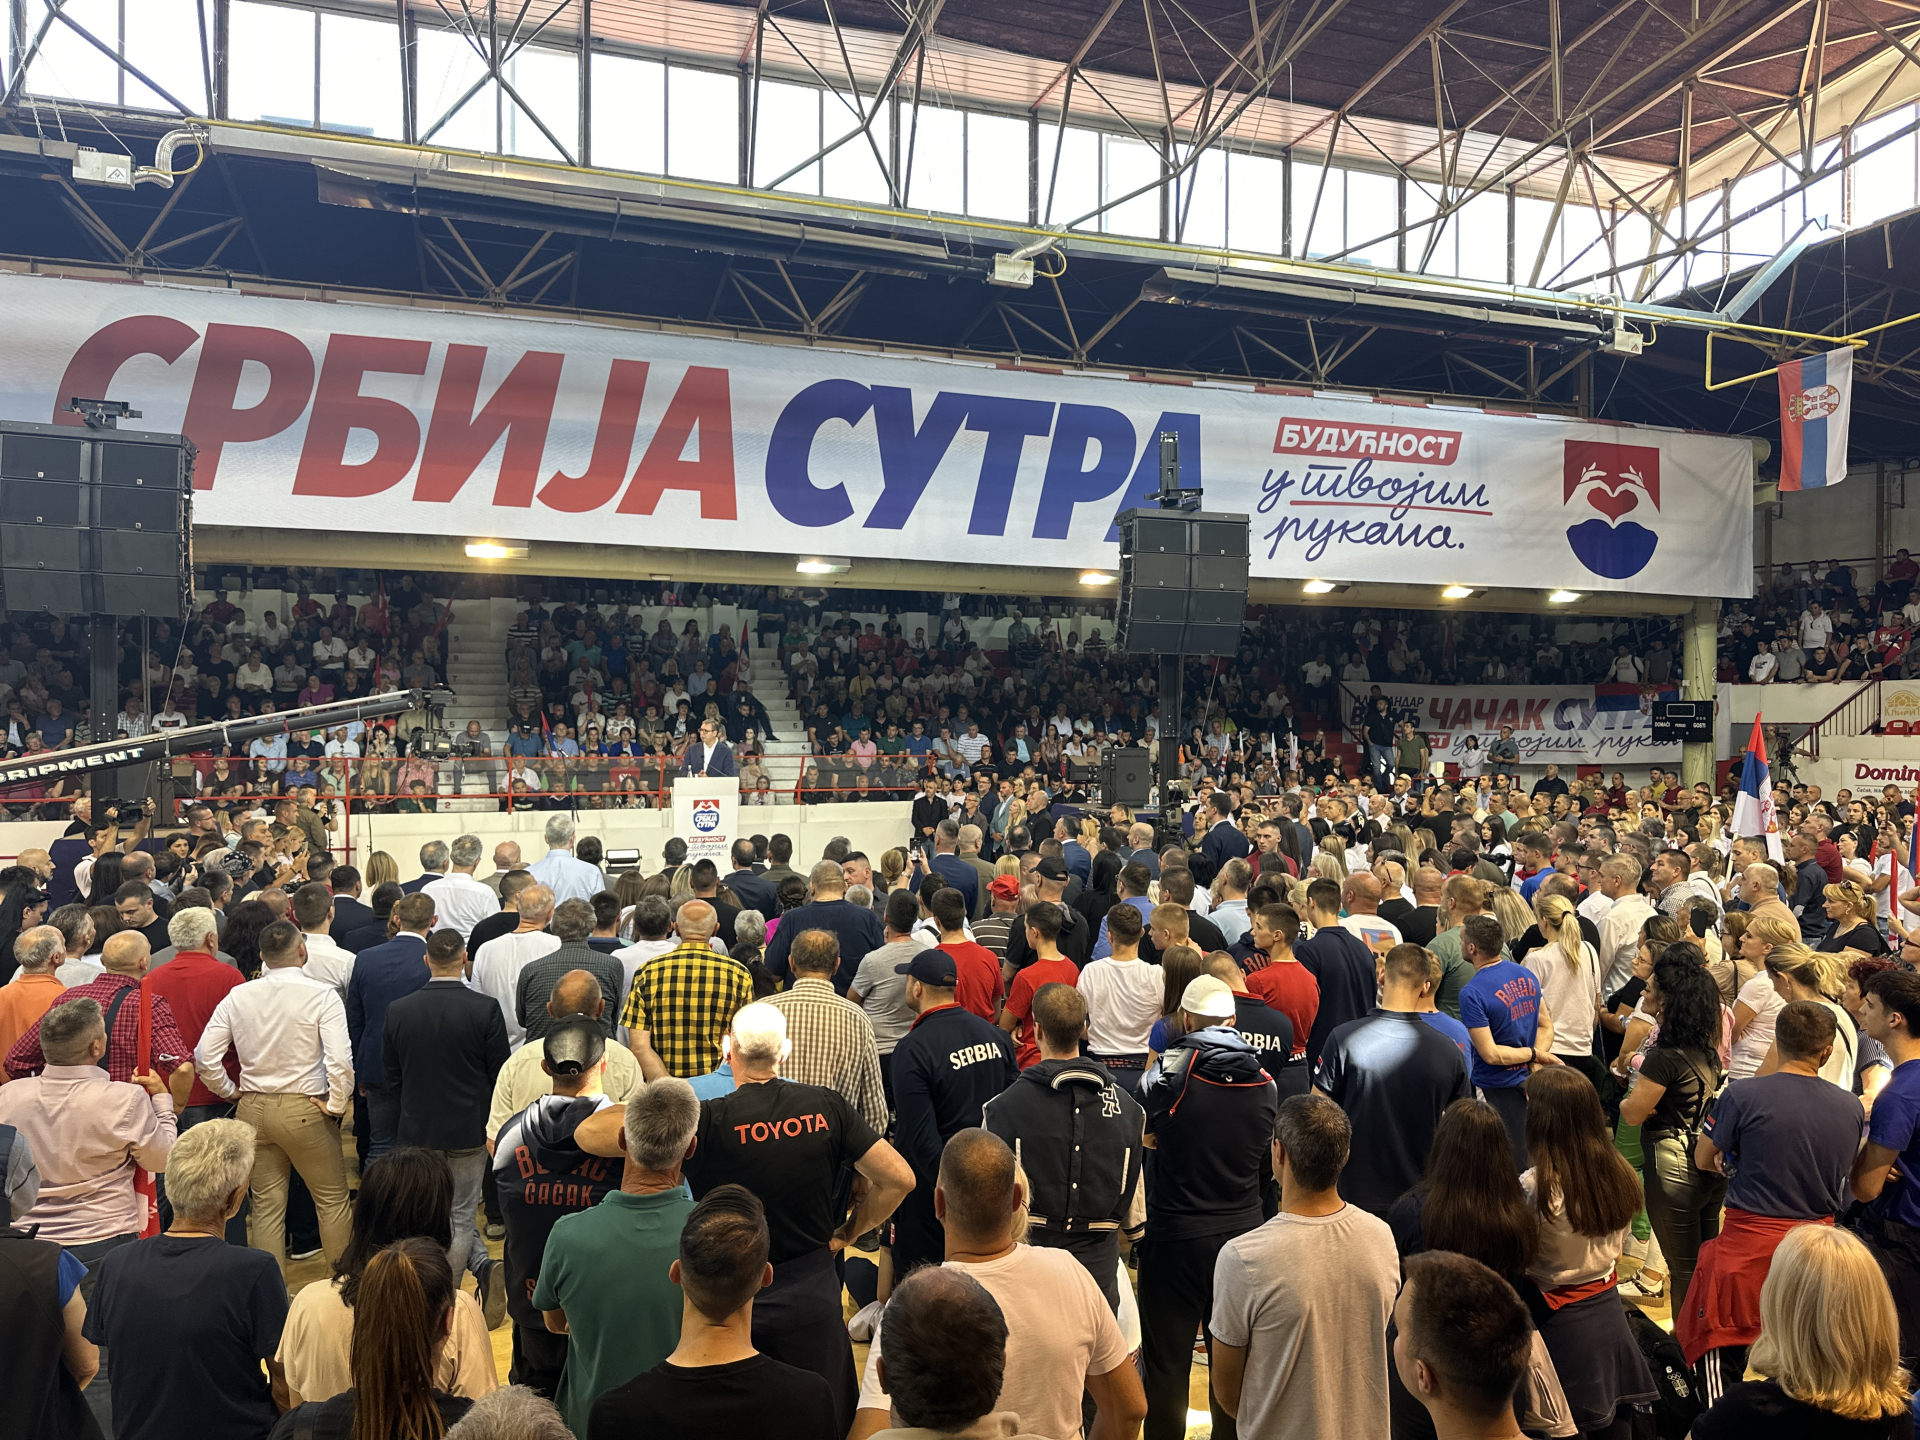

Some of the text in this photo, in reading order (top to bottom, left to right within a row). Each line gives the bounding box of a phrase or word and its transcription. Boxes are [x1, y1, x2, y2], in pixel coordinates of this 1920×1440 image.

[52, 315, 1202, 542] СРБИЈА СУТРА
[1280, 424, 1454, 460] БУДУЋНОСТ
[1257, 456, 1490, 521] у твојим
[1263, 516, 1465, 562] рукама.
[1428, 697, 1551, 731] ЧАЧАК
[444, 801, 451, 809] 2
[949, 1042, 1002, 1070] SERBIA
[734, 1113, 829, 1145] TOYOTA
